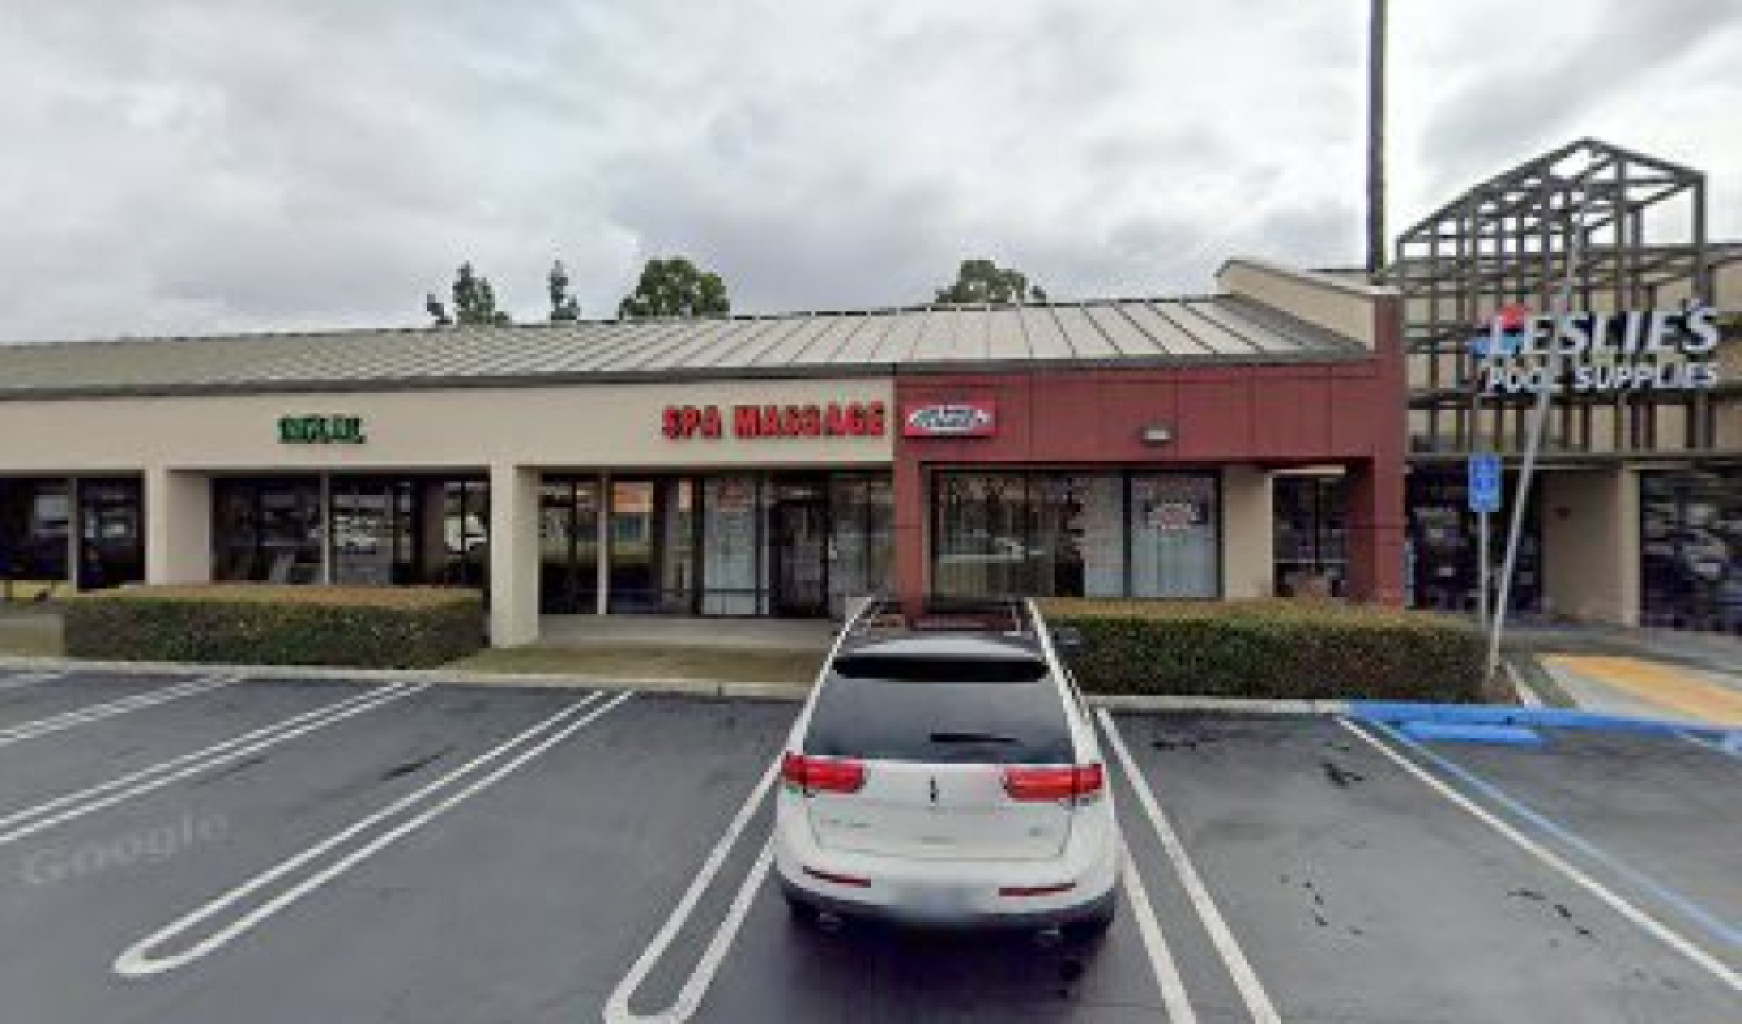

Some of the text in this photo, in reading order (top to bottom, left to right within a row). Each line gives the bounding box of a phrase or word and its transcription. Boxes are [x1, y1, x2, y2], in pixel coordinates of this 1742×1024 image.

[1570, 360, 1719, 390] SUPPLIES
[662, 405, 722, 439] SPA
[733, 401, 887, 438] MASSAGE
